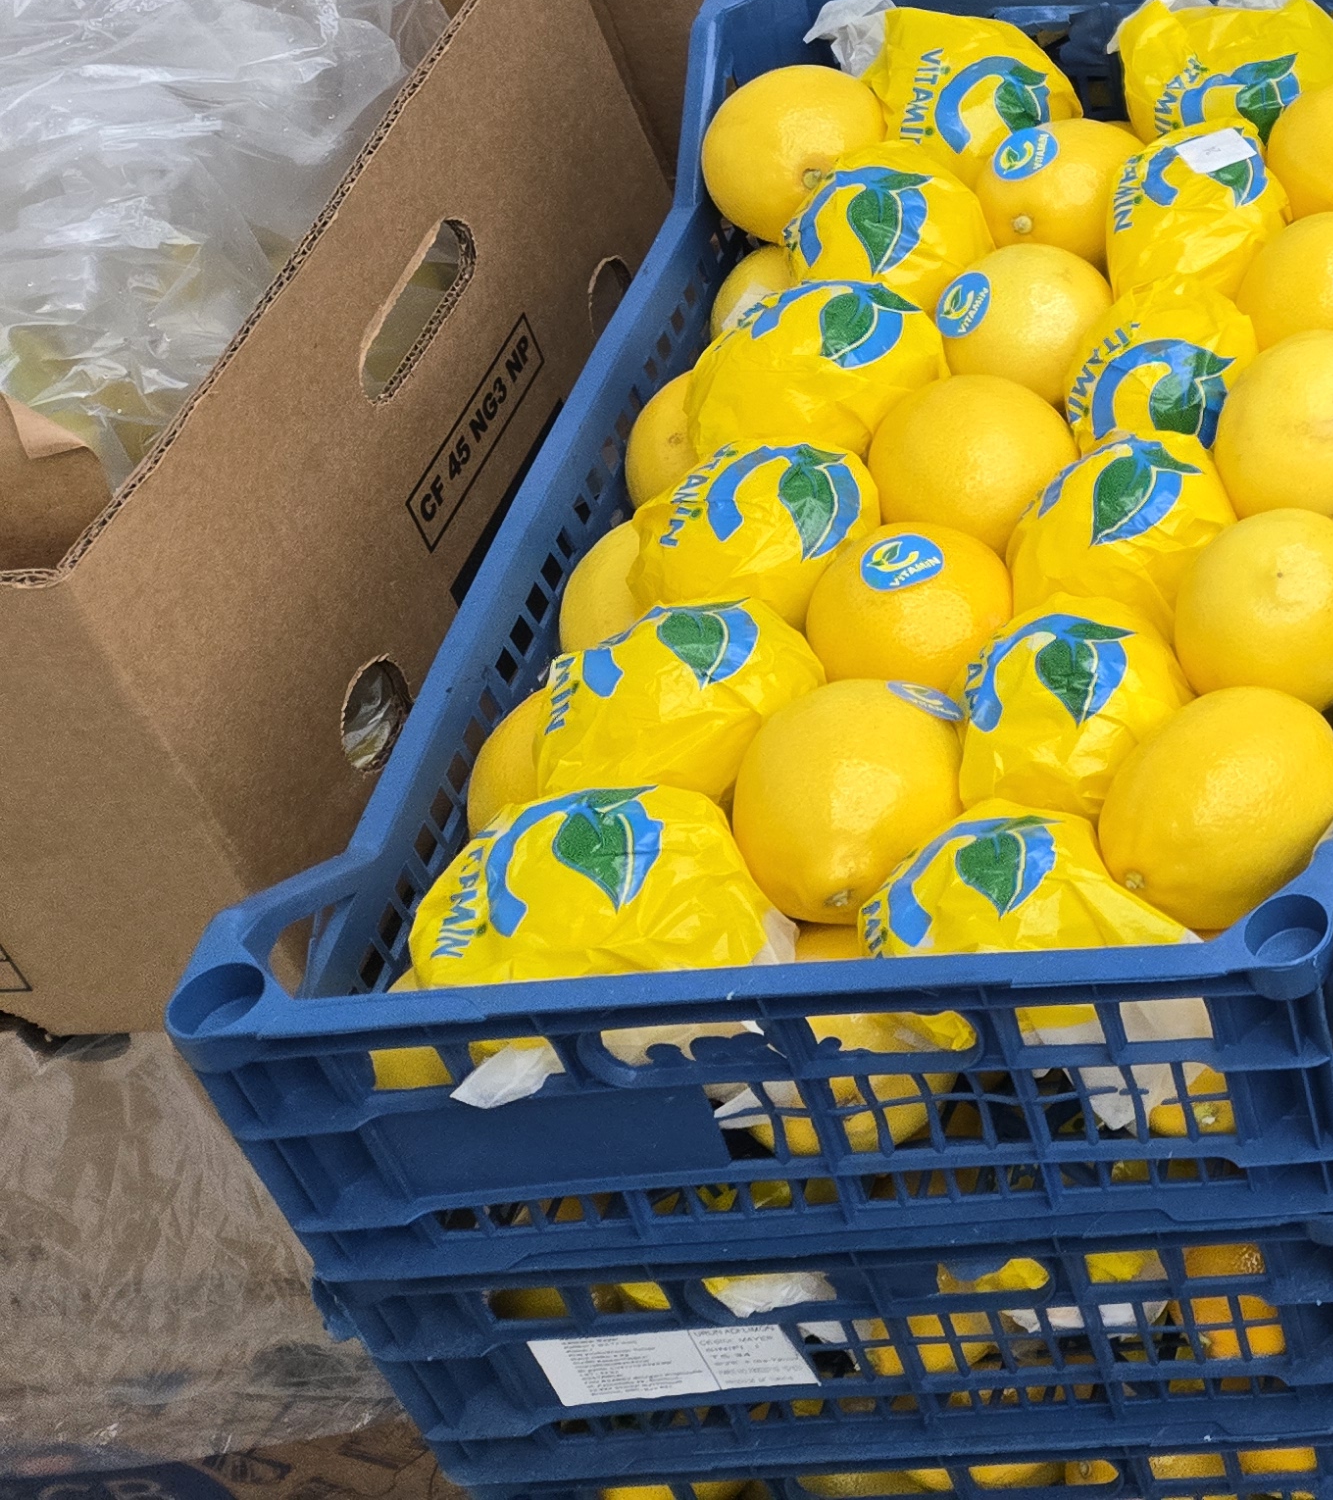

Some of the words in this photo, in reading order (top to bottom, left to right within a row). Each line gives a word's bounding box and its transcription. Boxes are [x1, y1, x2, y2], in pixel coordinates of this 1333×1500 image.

[420, 474, 444, 522] CF
[449, 435, 471, 480] 45
[468, 376, 507, 443] NG3
[504, 335, 529, 382] NP
